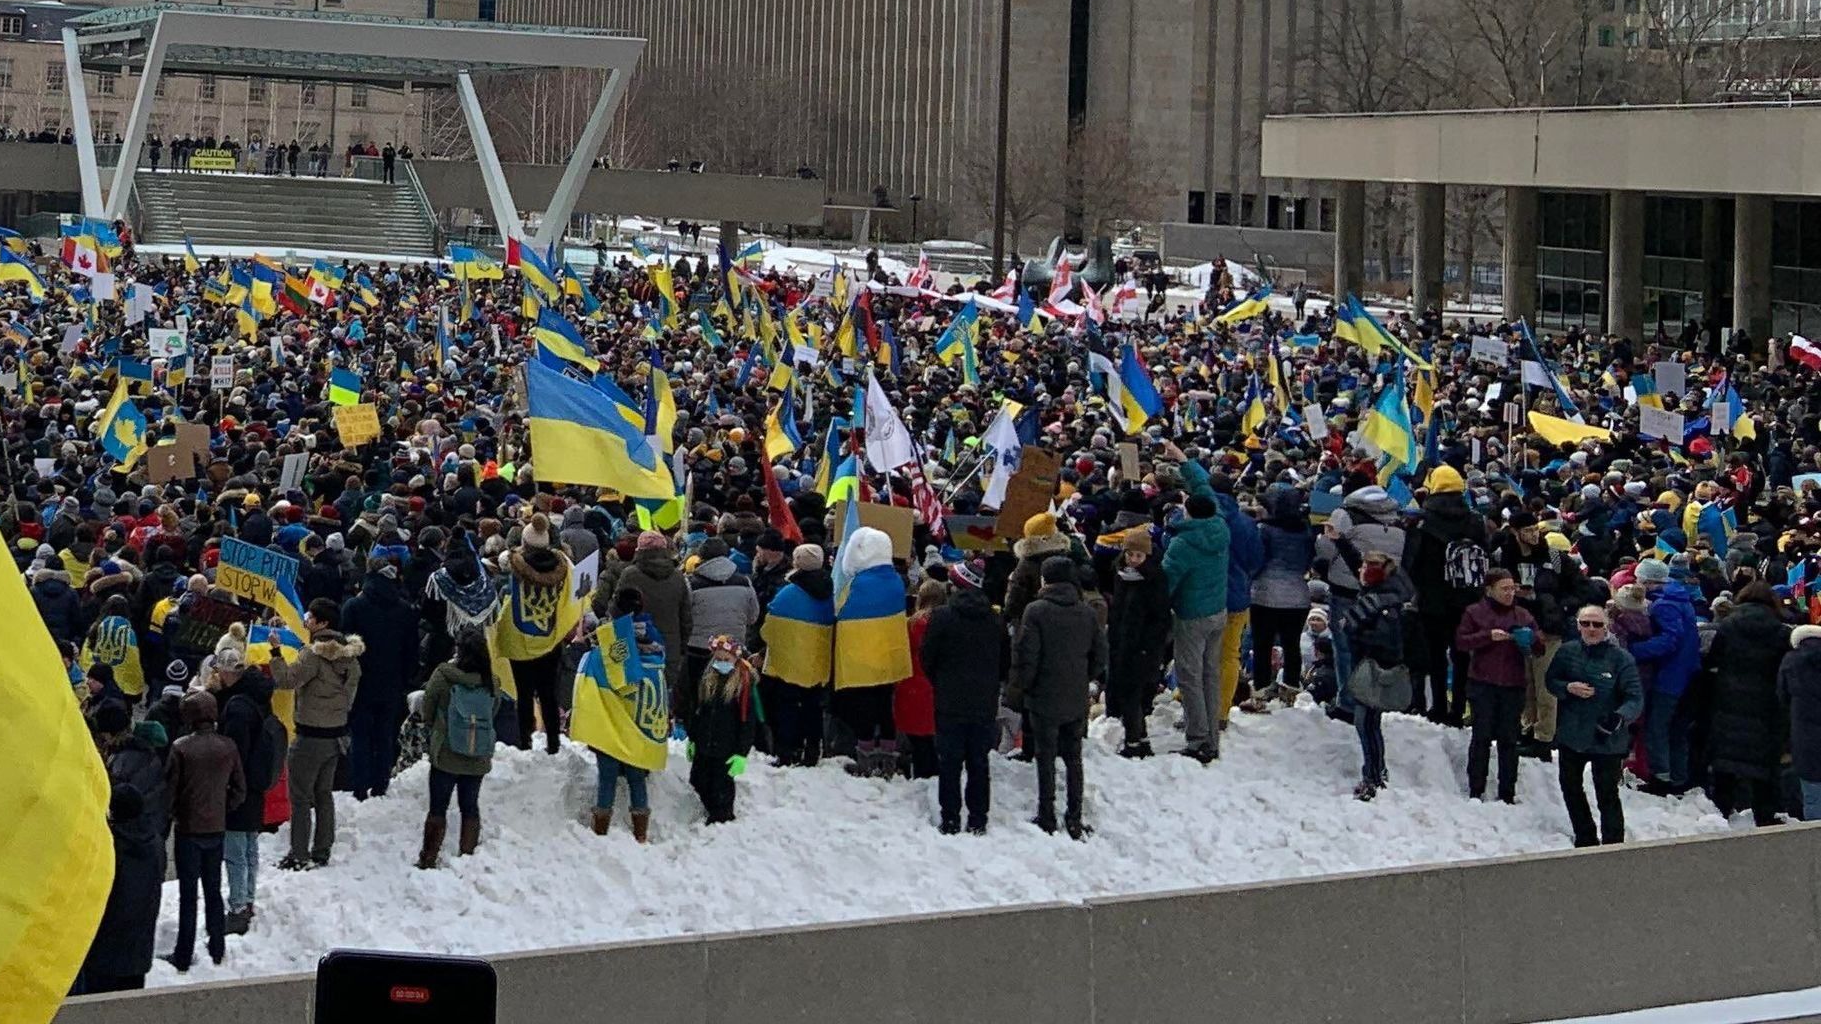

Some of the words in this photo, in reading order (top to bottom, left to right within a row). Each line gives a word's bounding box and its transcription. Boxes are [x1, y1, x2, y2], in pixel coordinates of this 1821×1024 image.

[194, 148, 232, 157] CAUTION
[221, 538, 258, 570] STOP
[220, 566, 260, 598] STOP
